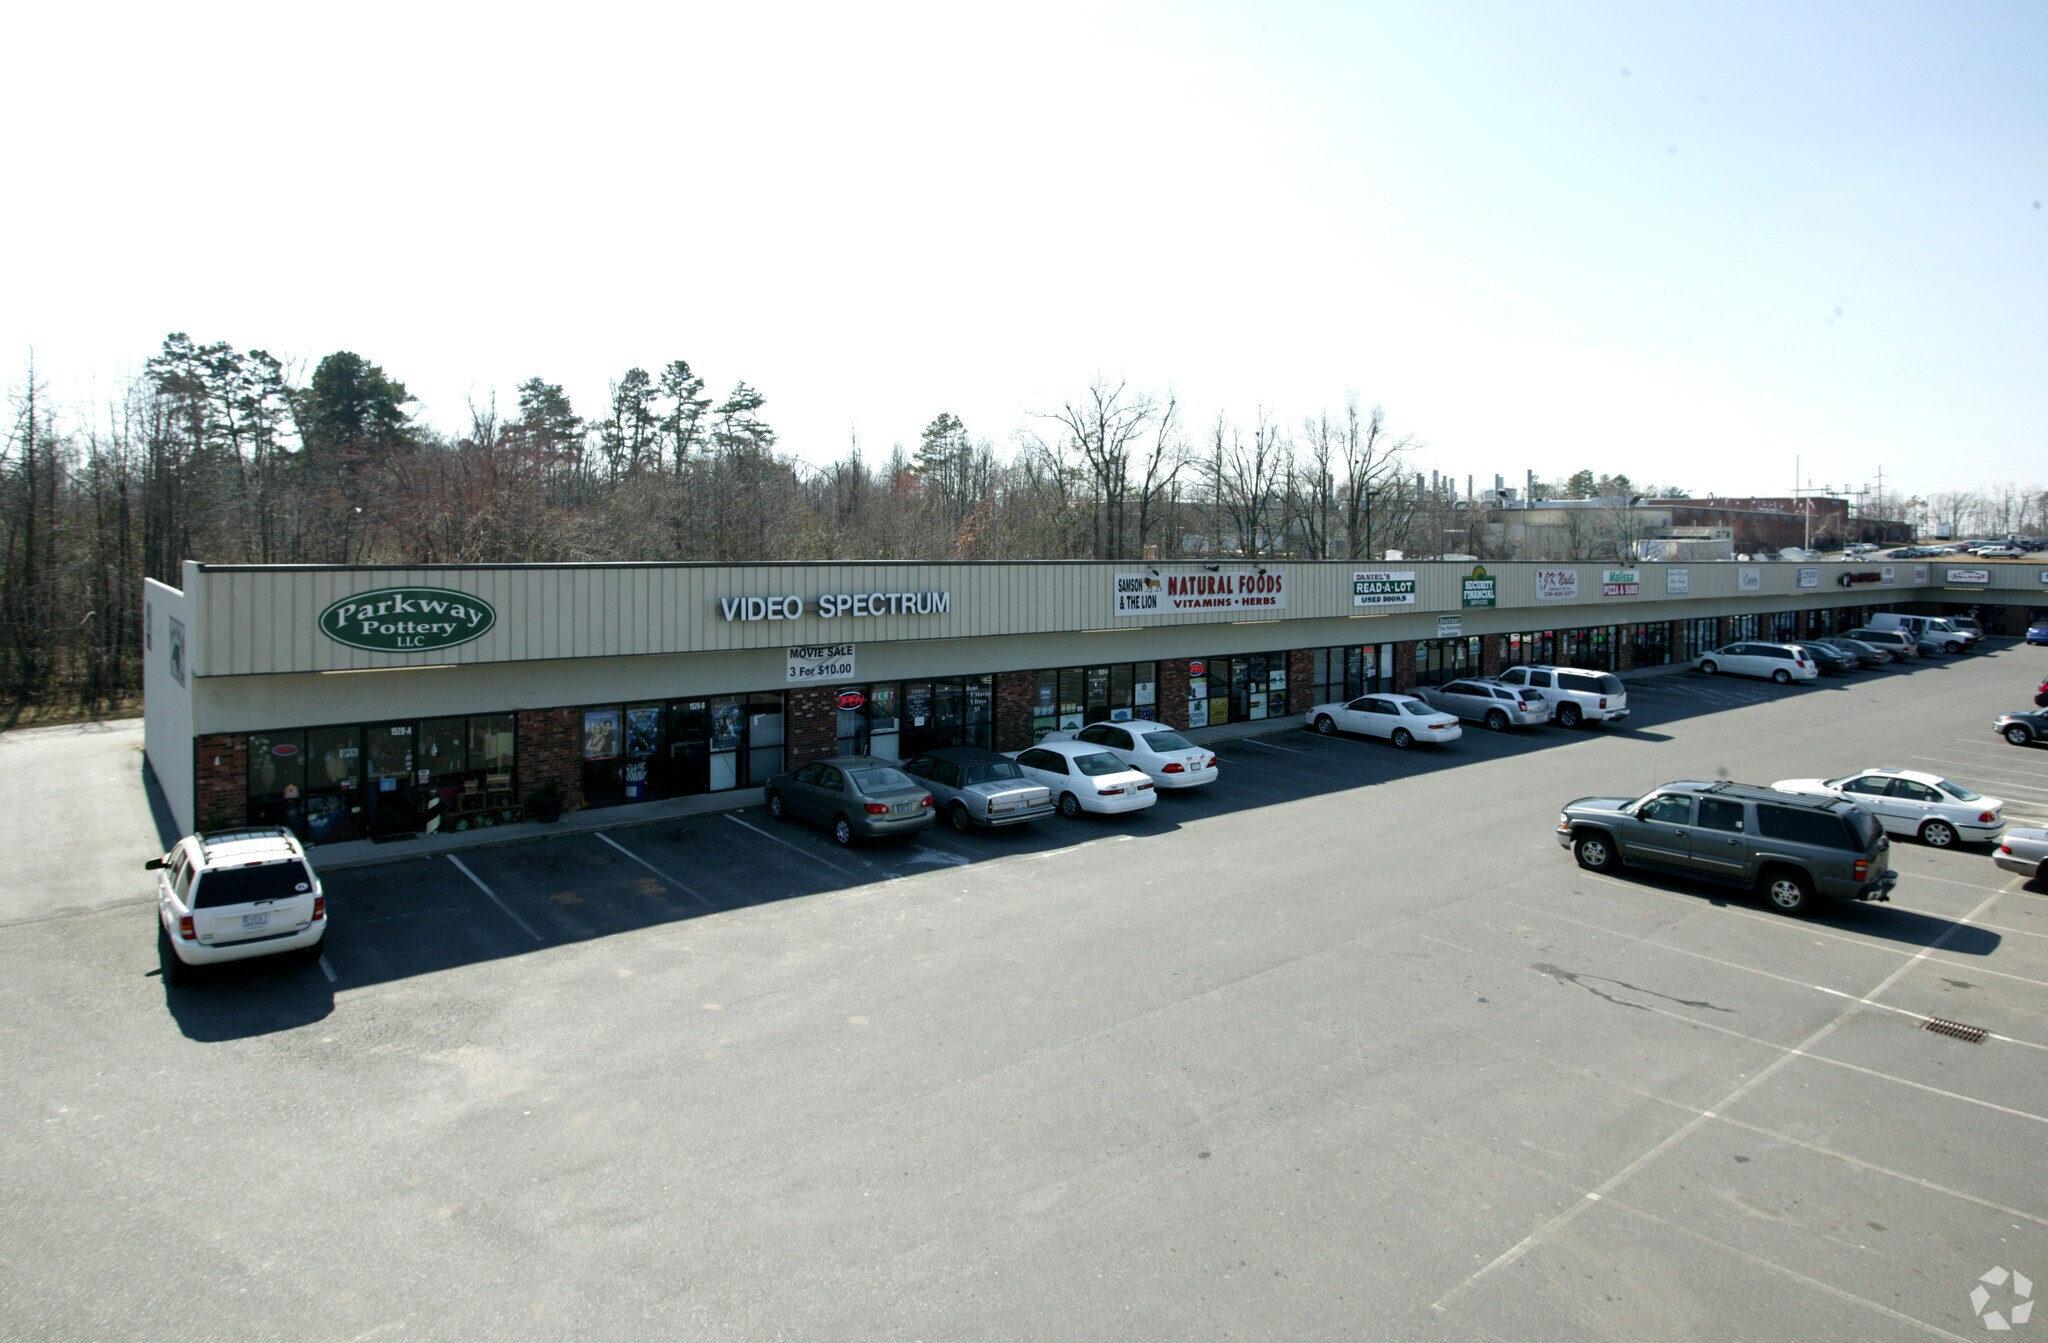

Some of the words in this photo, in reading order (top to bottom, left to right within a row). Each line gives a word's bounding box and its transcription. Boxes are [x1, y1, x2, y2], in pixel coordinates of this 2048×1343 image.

[1356, 573, 1391, 581] DANIEL'S
[1609, 571, 1634, 582] Malissa
[1118, 578, 1143, 593] SAMSON
[1168, 576, 1233, 596] NATURAL
[1239, 574, 1283, 594] FOODS
[1356, 581, 1412, 594] READ-A-LOT
[1464, 580, 1494, 590] SECURITY
[1604, 585, 1619, 595] PIZZA
[1620, 585, 1625, 594] &
[1625, 584, 1639, 594] SUBS
[1382, 595, 1407, 603] BOOKS
[1463, 589, 1495, 600] FINANCIAL
[719, 595, 804, 622] VIDEO
[818, 591, 950, 618] SPECTRUM
[1119, 598, 1125, 610] &
[1127, 596, 1140, 609] THE
[1141, 595, 1157, 609] LION
[1173, 598, 1231, 609] VITAMINS
[1241, 596, 1276, 606] HERBS
[335, 593, 484, 629] Parkway
[360, 620, 458, 637] Pottery
[396, 635, 425, 647] LLC
[789, 647, 824, 660] MOVIE
[826, 645, 853, 658] SALE
[789, 667, 796, 677] 3
[799, 666, 816, 677] For
[818, 663, 851, 676] $10.00
[871, 691, 895, 701] RENT
[390, 726, 412, 736] 1528-A
